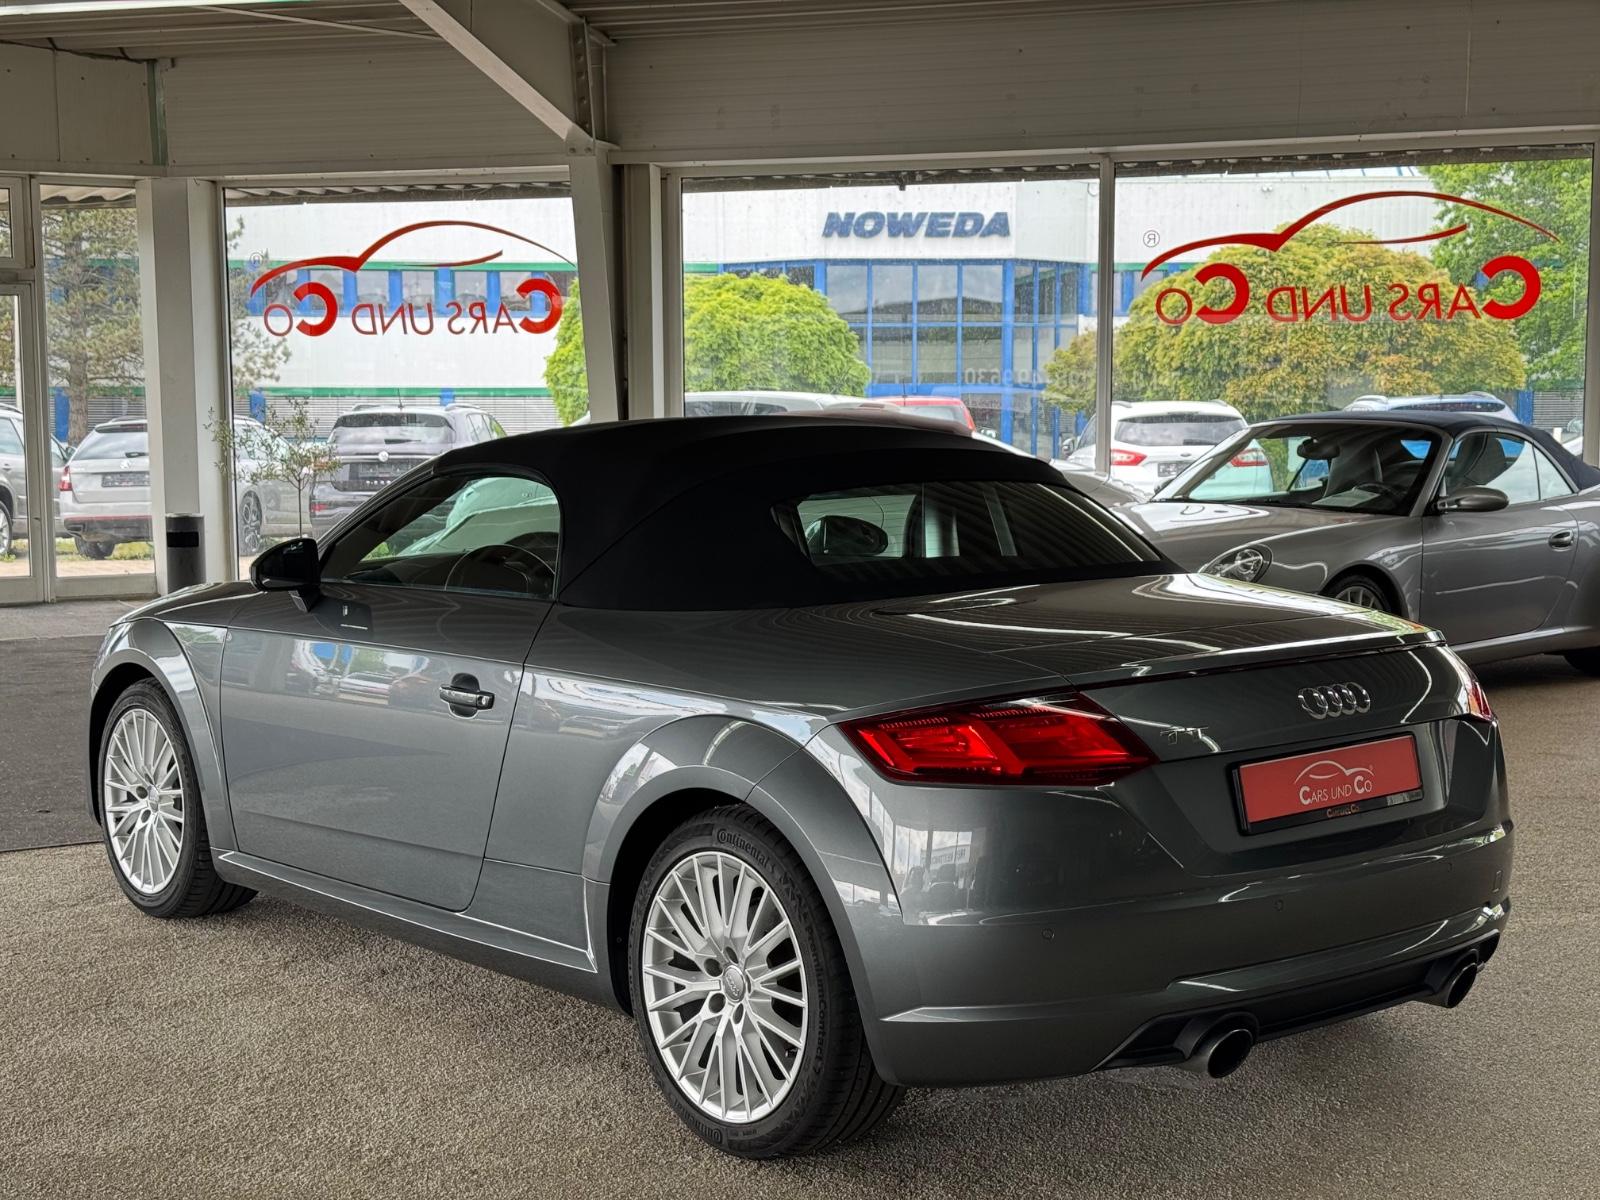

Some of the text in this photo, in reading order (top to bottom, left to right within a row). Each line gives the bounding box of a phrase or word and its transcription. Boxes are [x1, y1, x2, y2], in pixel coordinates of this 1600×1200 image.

[822, 211, 1011, 239] NOWEDA
[1299, 785, 1329, 805] CARS
[1330, 784, 1353, 800] UND
[716, 828, 771, 869] Continental
